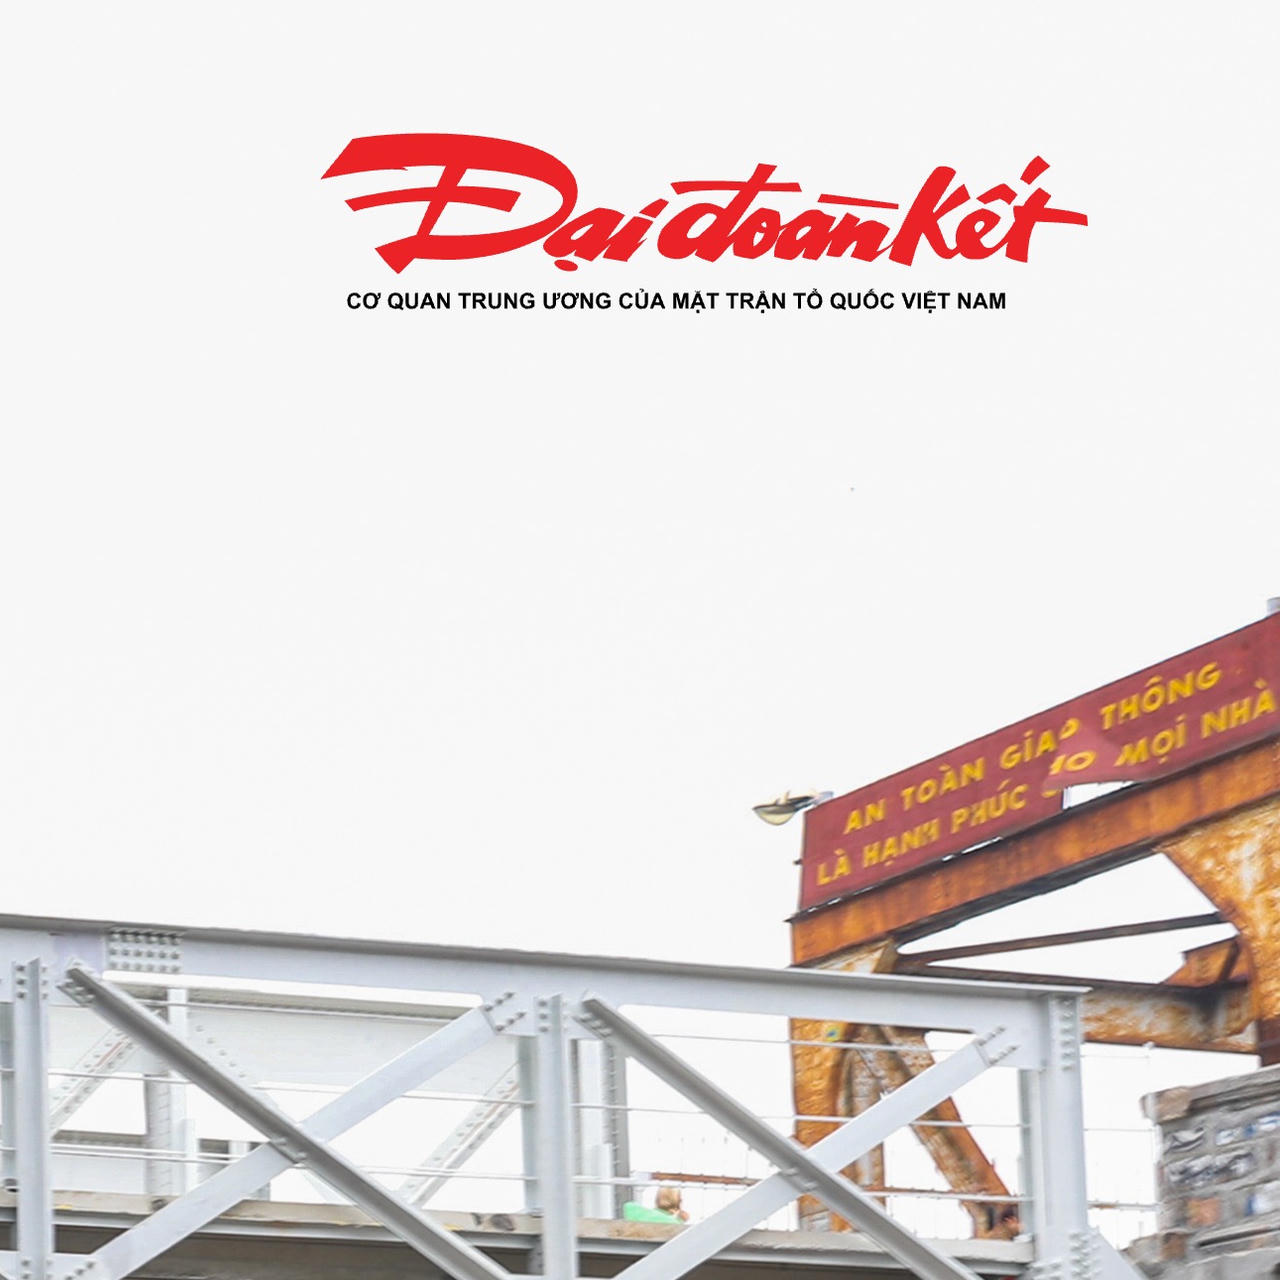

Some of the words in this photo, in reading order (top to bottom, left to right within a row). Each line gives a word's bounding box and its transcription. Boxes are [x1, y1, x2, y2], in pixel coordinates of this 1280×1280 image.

[816, 848, 852, 886] LÀ
[862, 818, 940, 868] HẠNH
[950, 778, 1030, 834] PHÚC
[1115, 714, 1188, 765] MỌI
[1200, 678, 1277, 738] NHÀ
[844, 799, 887, 834] AN
[900, 757, 986, 811] TOÀN
[1099, 661, 1223, 730] THÔNG
